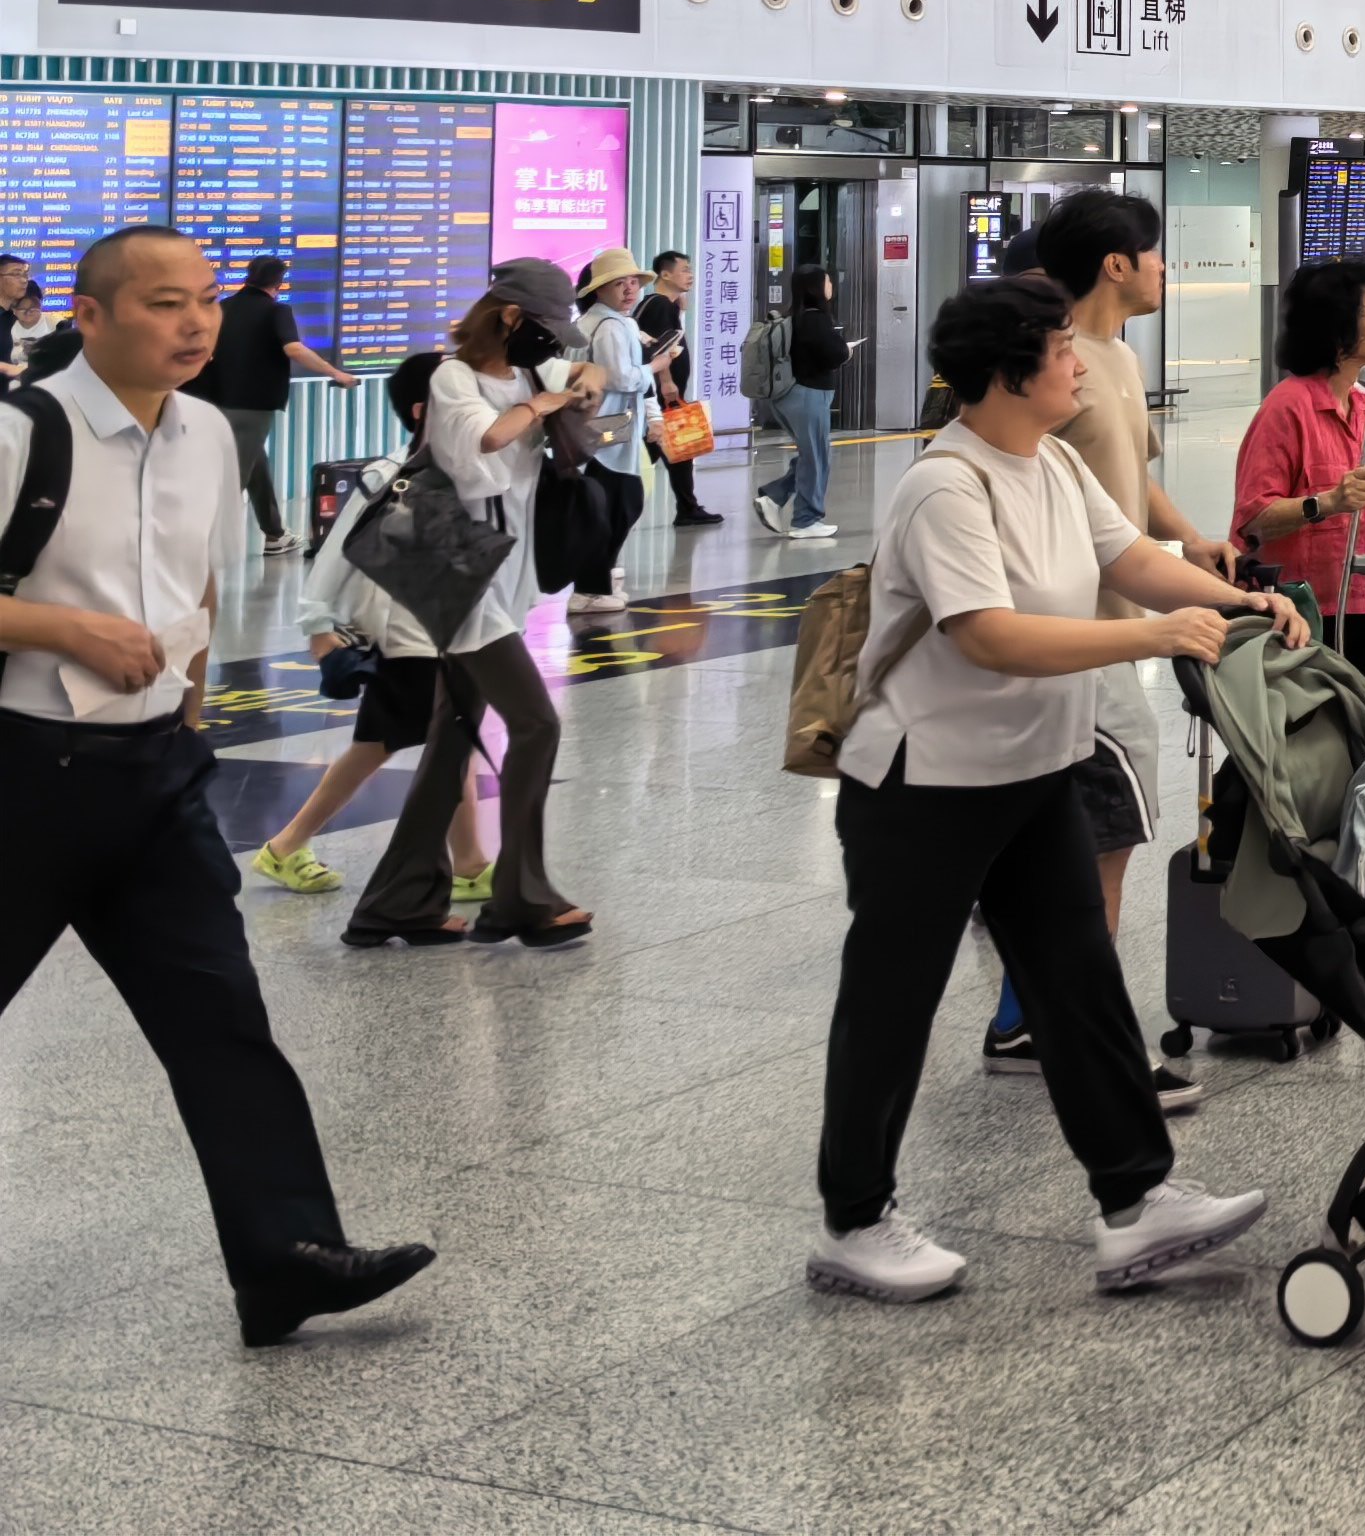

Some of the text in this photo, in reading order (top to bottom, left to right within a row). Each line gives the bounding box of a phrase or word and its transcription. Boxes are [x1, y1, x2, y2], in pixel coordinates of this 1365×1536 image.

[1142, 29, 1169, 51] Lift
[513, 167, 608, 192] 掌上乘机
[718, 250, 740, 397] 无障碍电梯
